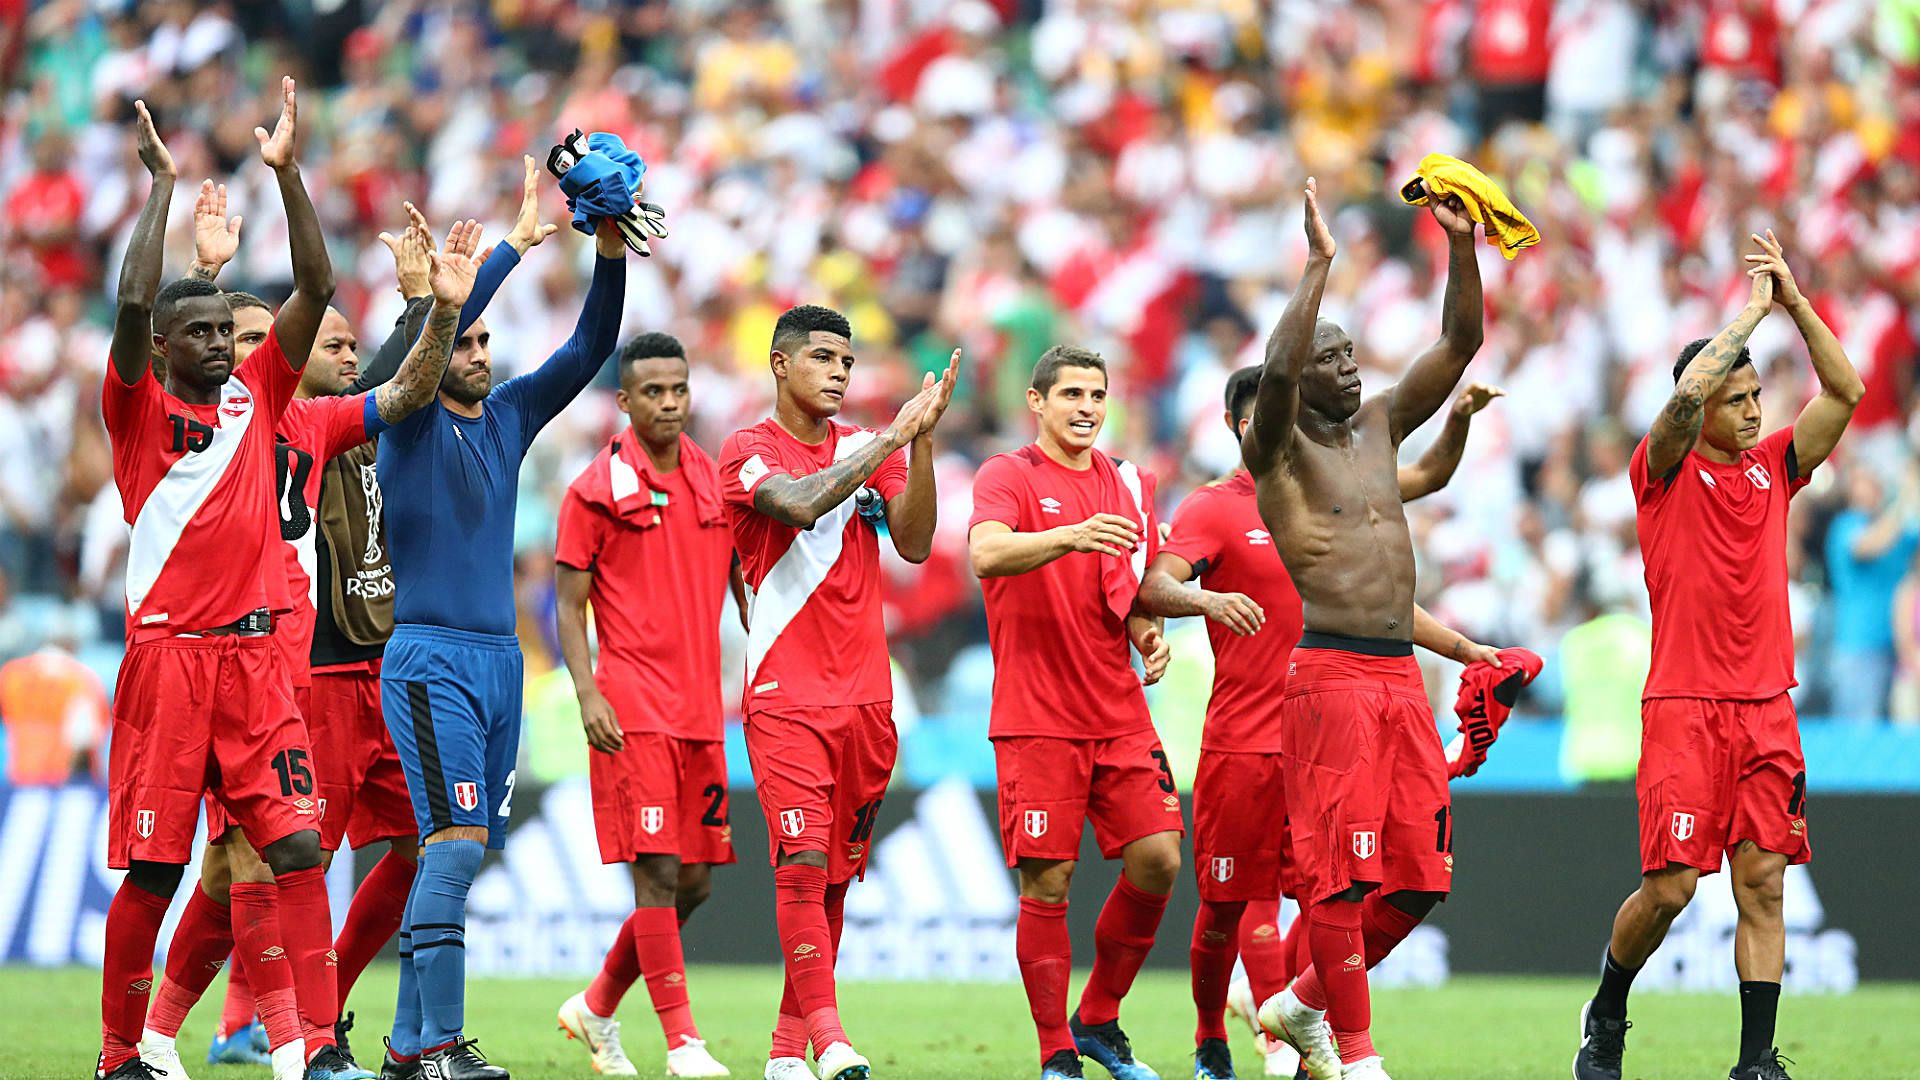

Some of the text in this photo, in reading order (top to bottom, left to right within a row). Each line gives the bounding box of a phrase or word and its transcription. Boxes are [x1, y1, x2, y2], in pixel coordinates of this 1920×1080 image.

[168, 413, 214, 453] 15
[271, 750, 313, 796] 15
[1151, 750, 1174, 793] 3
[1787, 771, 1806, 817] 1
[1435, 805, 1453, 853] 1
